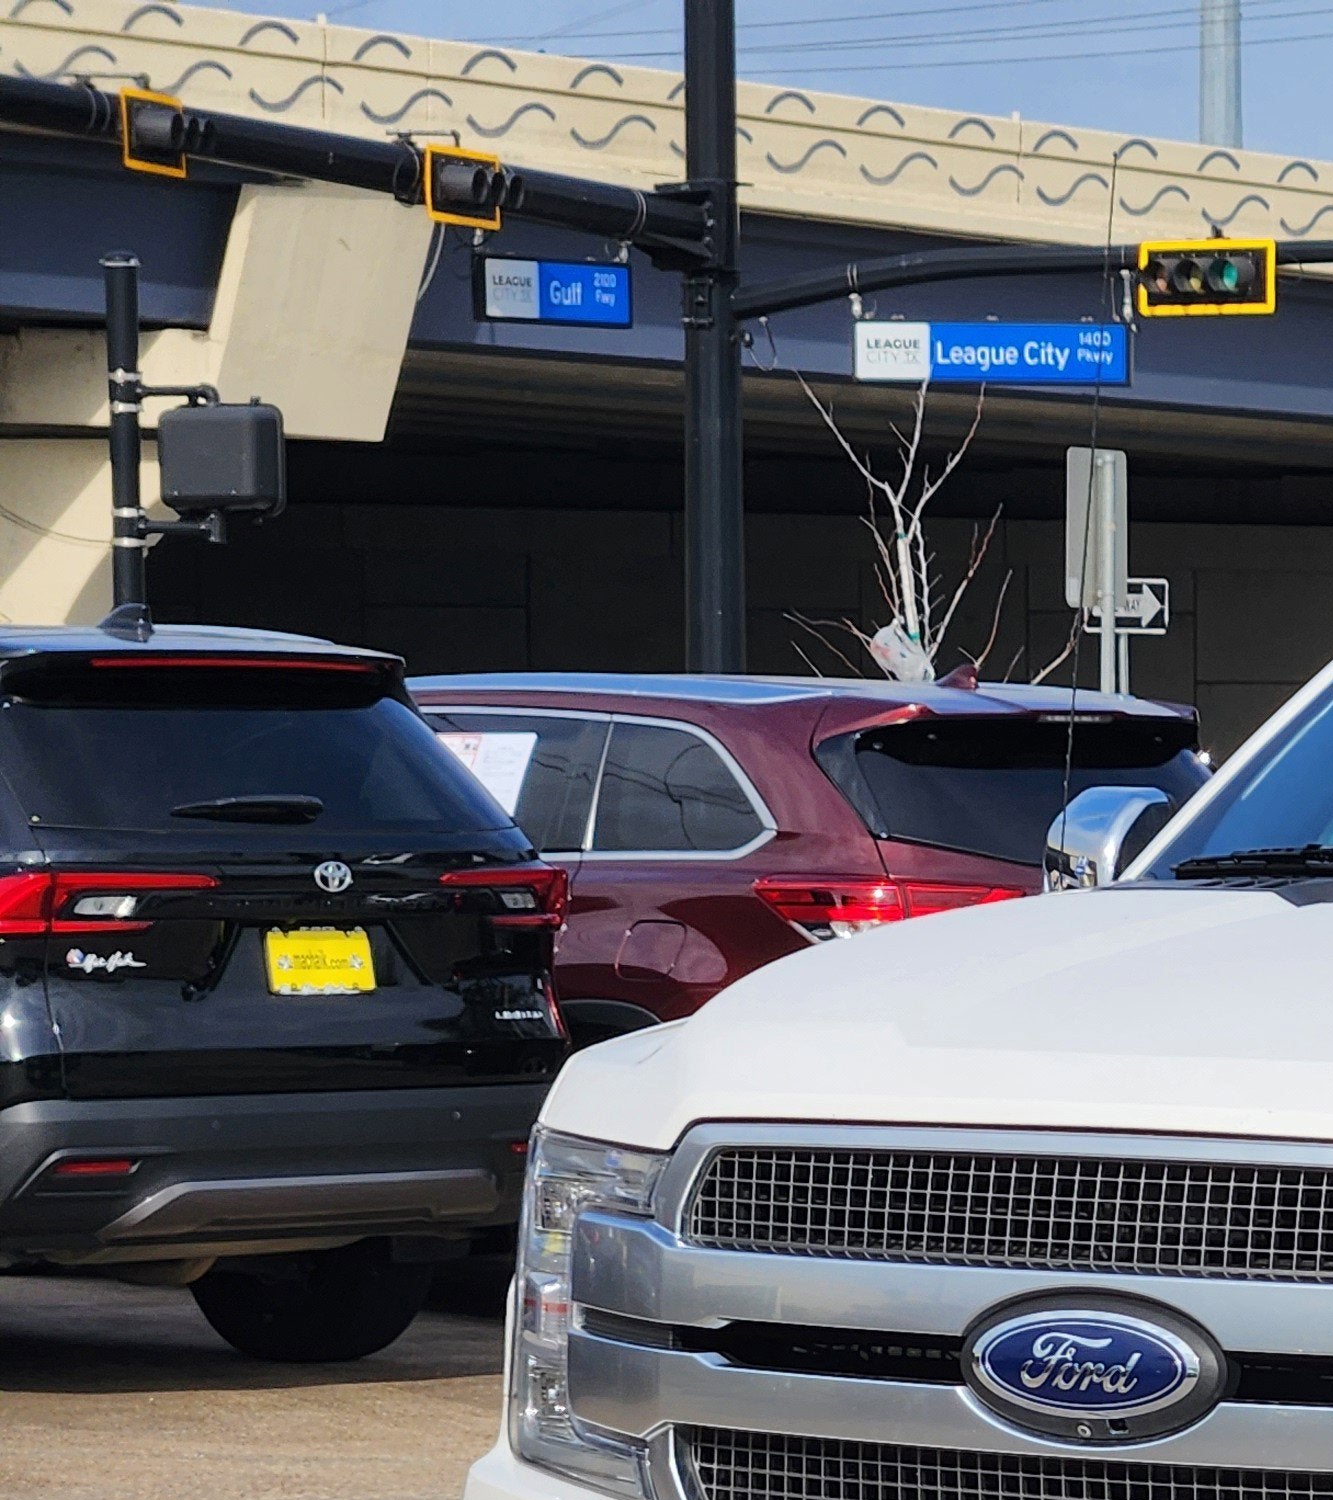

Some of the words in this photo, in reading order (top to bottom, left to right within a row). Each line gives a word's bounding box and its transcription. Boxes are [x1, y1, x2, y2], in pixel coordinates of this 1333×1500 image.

[492, 275, 533, 287] LEAGUE
[550, 280, 582, 306] Gulf
[866, 339, 920, 349] LEAGUE
[1078, 330, 1111, 347] 1400
[866, 350, 898, 364] CITY
[936, 340, 1019, 372] League
[1023, 341, 1070, 371] City
[1020, 1331, 1142, 1394] Ford
